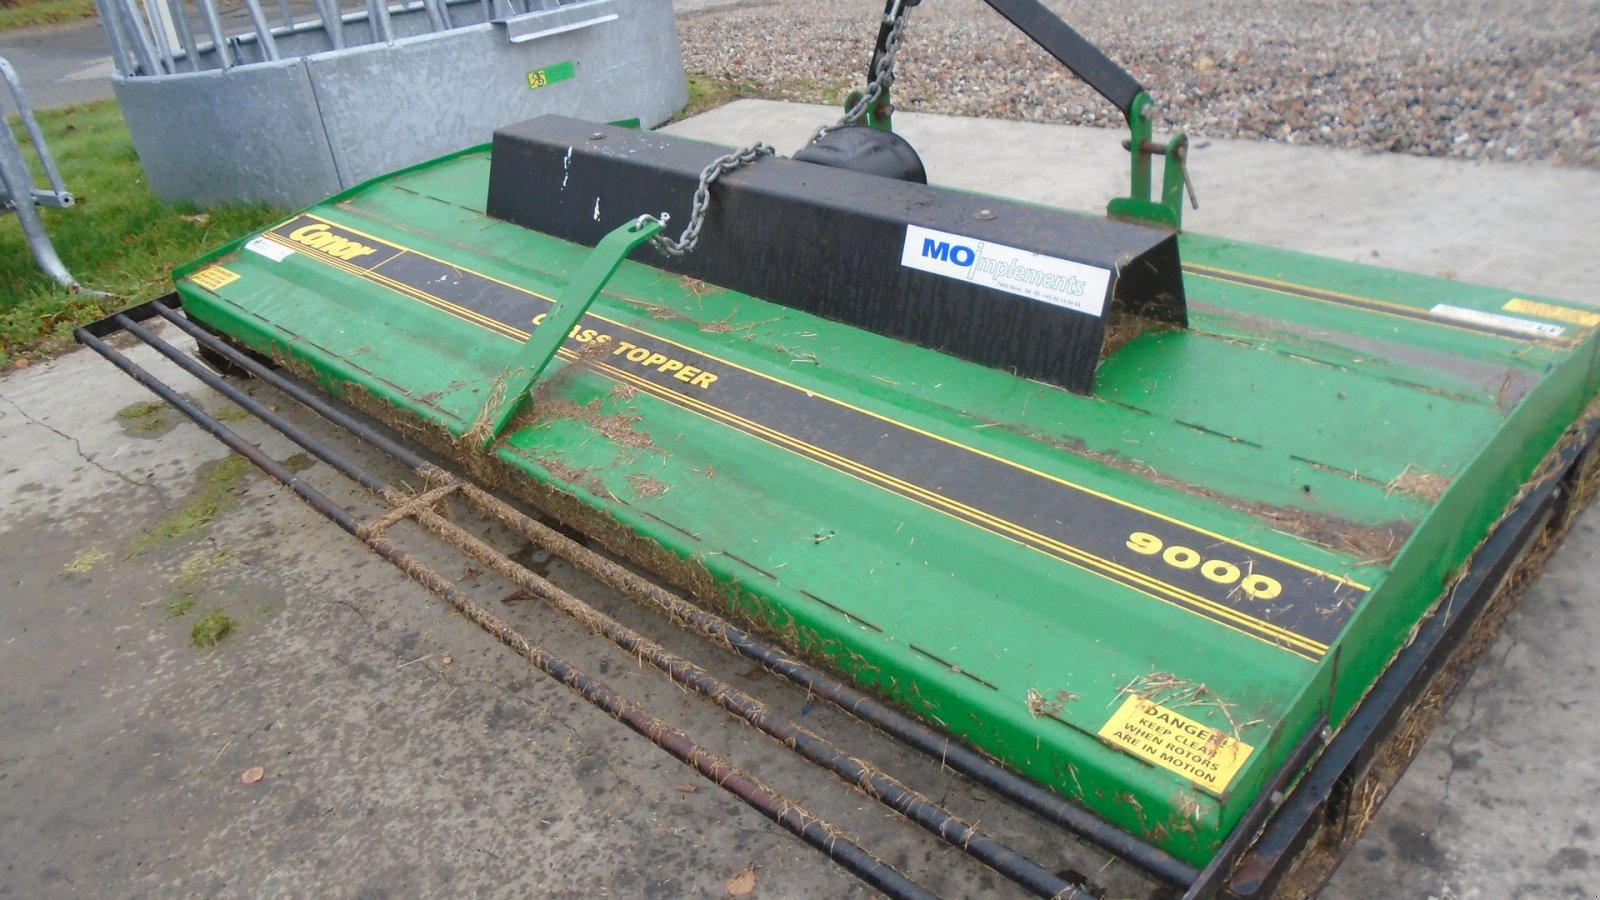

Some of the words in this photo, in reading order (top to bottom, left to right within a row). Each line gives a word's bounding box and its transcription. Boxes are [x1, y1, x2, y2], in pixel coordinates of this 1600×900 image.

[289, 223, 377, 260] Conor
[613, 341, 719, 390] TOPPER
[1126, 531, 1282, 599] 9000
[1113, 730, 1141, 747] ARE
[1142, 743, 1157, 756] IN
[1159, 754, 1216, 783] MOTION
[1124, 722, 1163, 746] WHEN
[1165, 742, 1220, 772] ROTORS
[1138, 717, 1172, 738] KEEP
[1174, 734, 1218, 759] CLEAR
